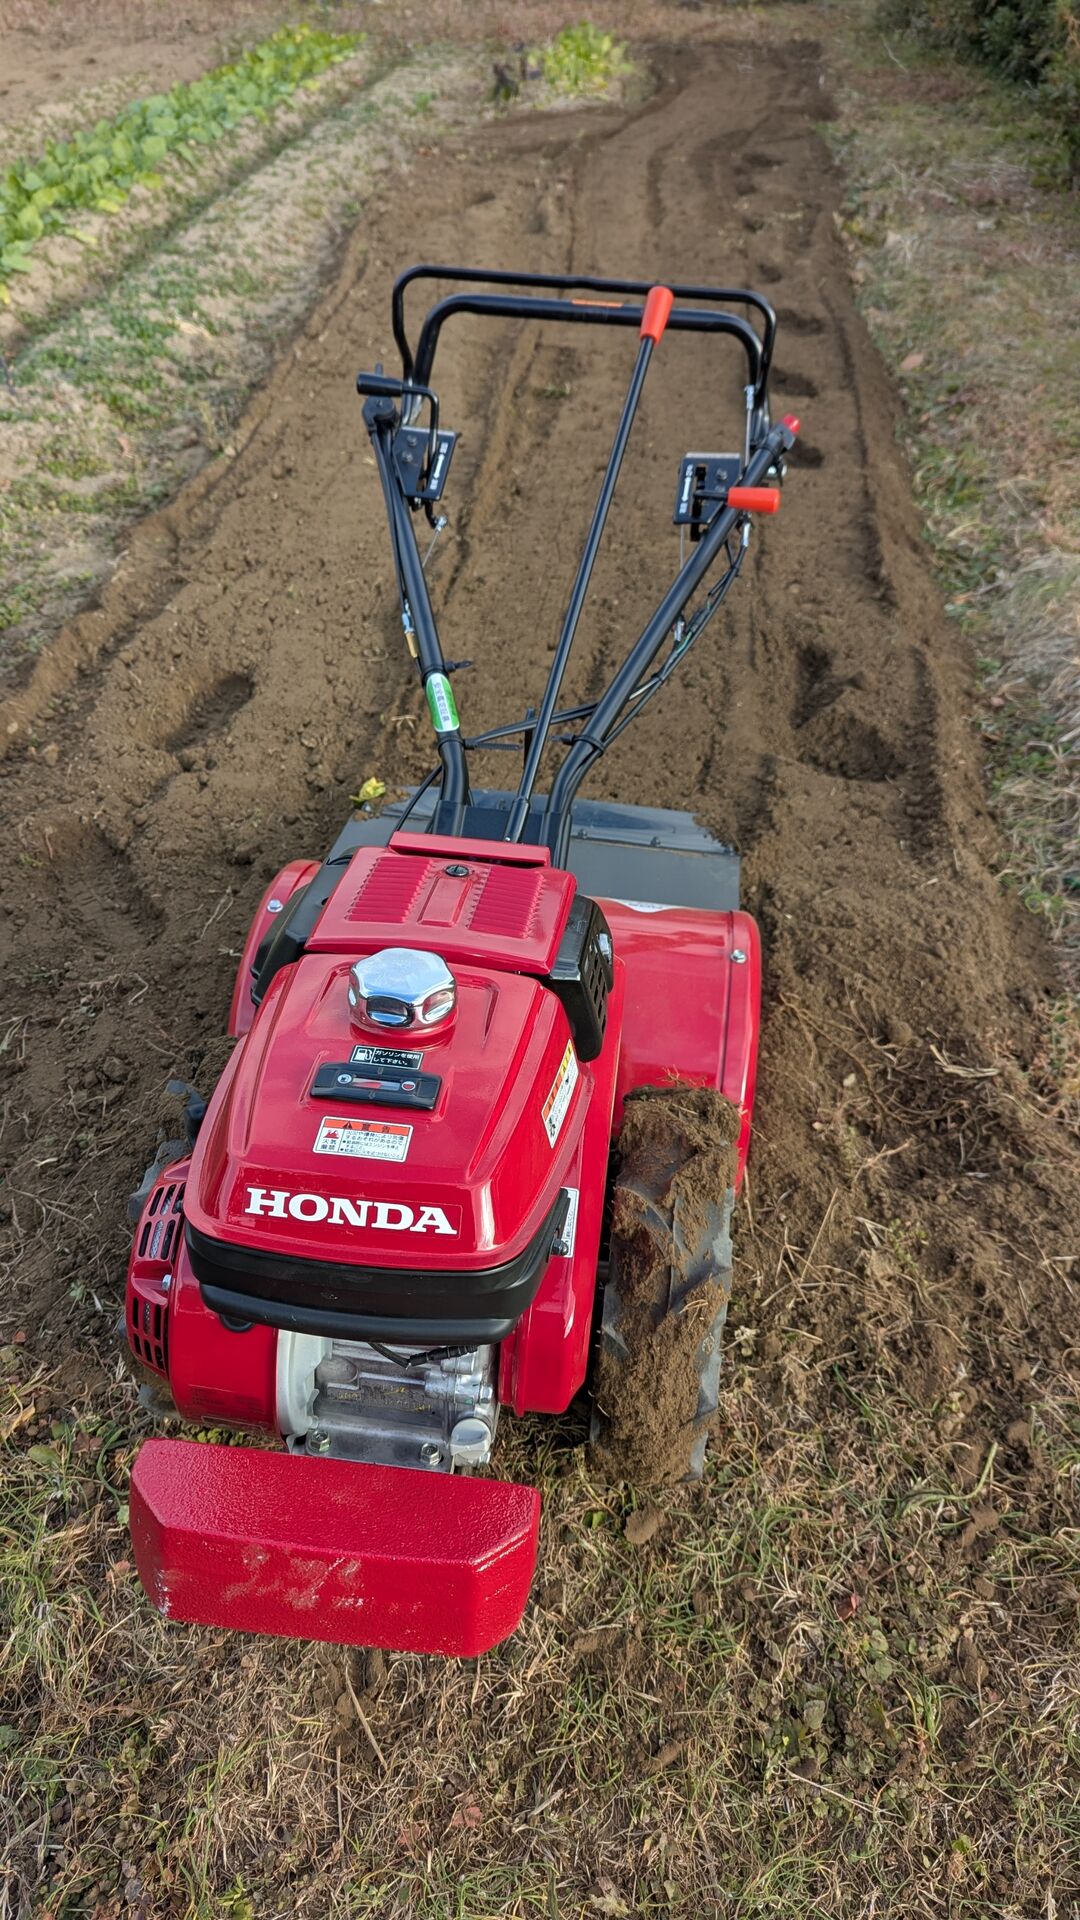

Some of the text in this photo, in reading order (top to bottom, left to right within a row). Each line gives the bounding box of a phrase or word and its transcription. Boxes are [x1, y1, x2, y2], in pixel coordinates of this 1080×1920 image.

[375, 1050, 419, 1060] ガソリンを使用
[373, 1057, 408, 1065] して下さい。
[245, 1187, 458, 1235] HONDA
